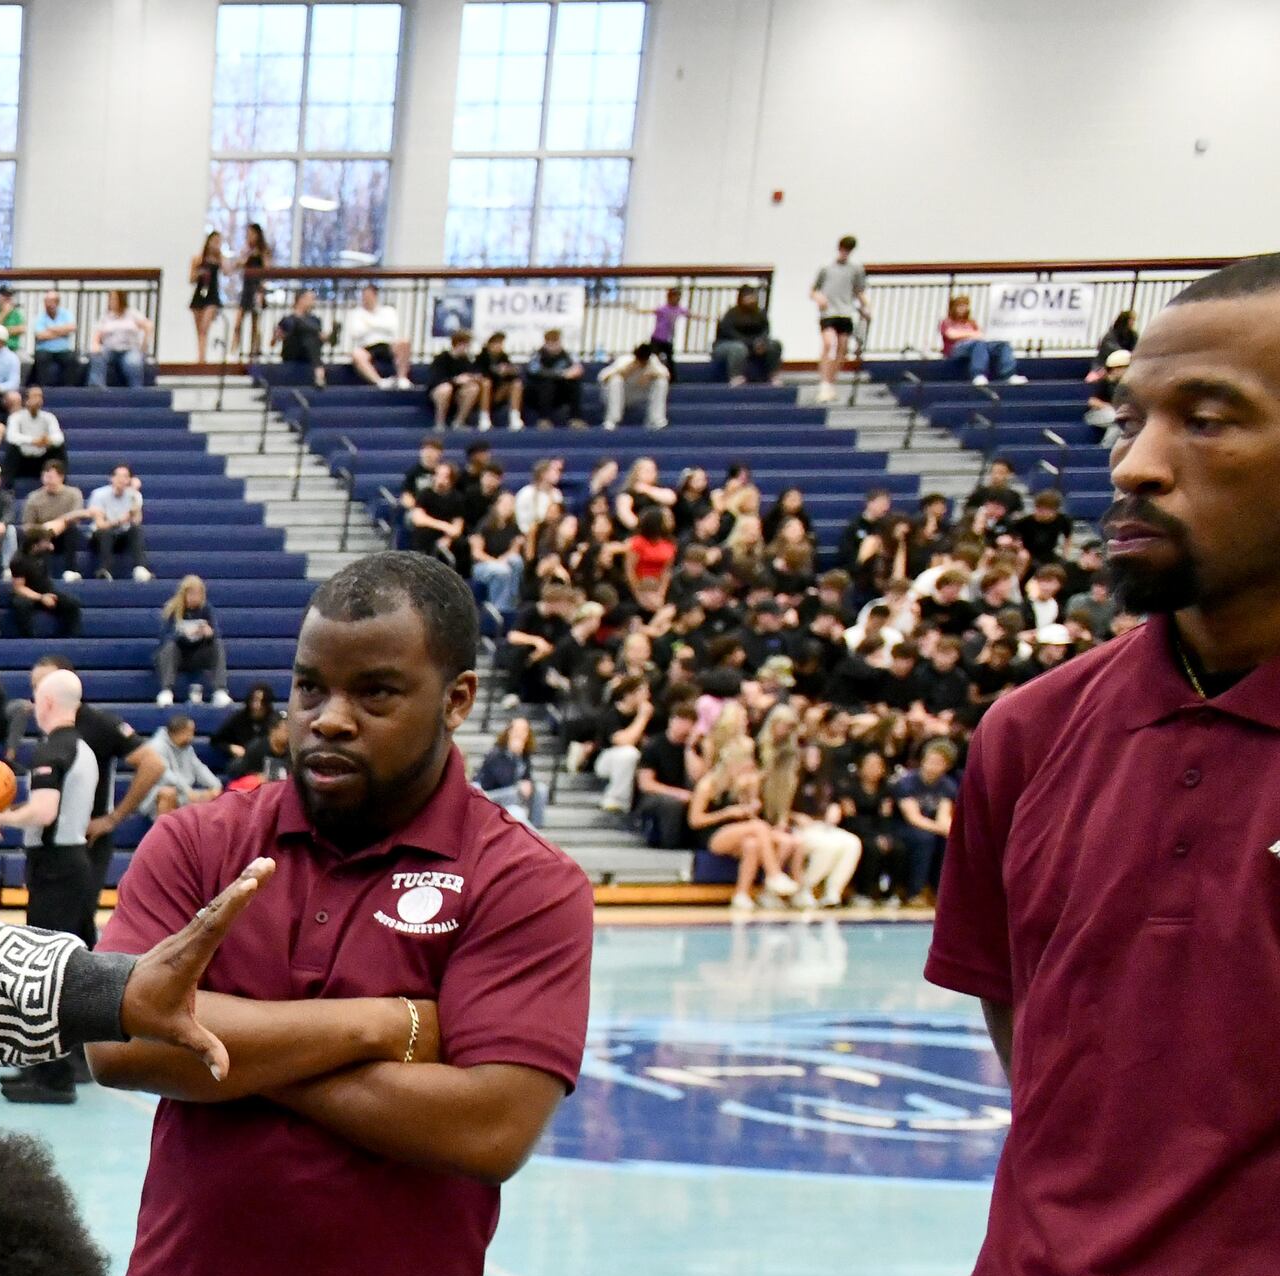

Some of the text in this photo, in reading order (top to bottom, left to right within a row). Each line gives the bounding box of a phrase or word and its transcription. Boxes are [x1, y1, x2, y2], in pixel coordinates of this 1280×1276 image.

[489, 292, 570, 314] HOME
[1000, 288, 1082, 310] HOME
[391, 871, 464, 894] TUCKER
